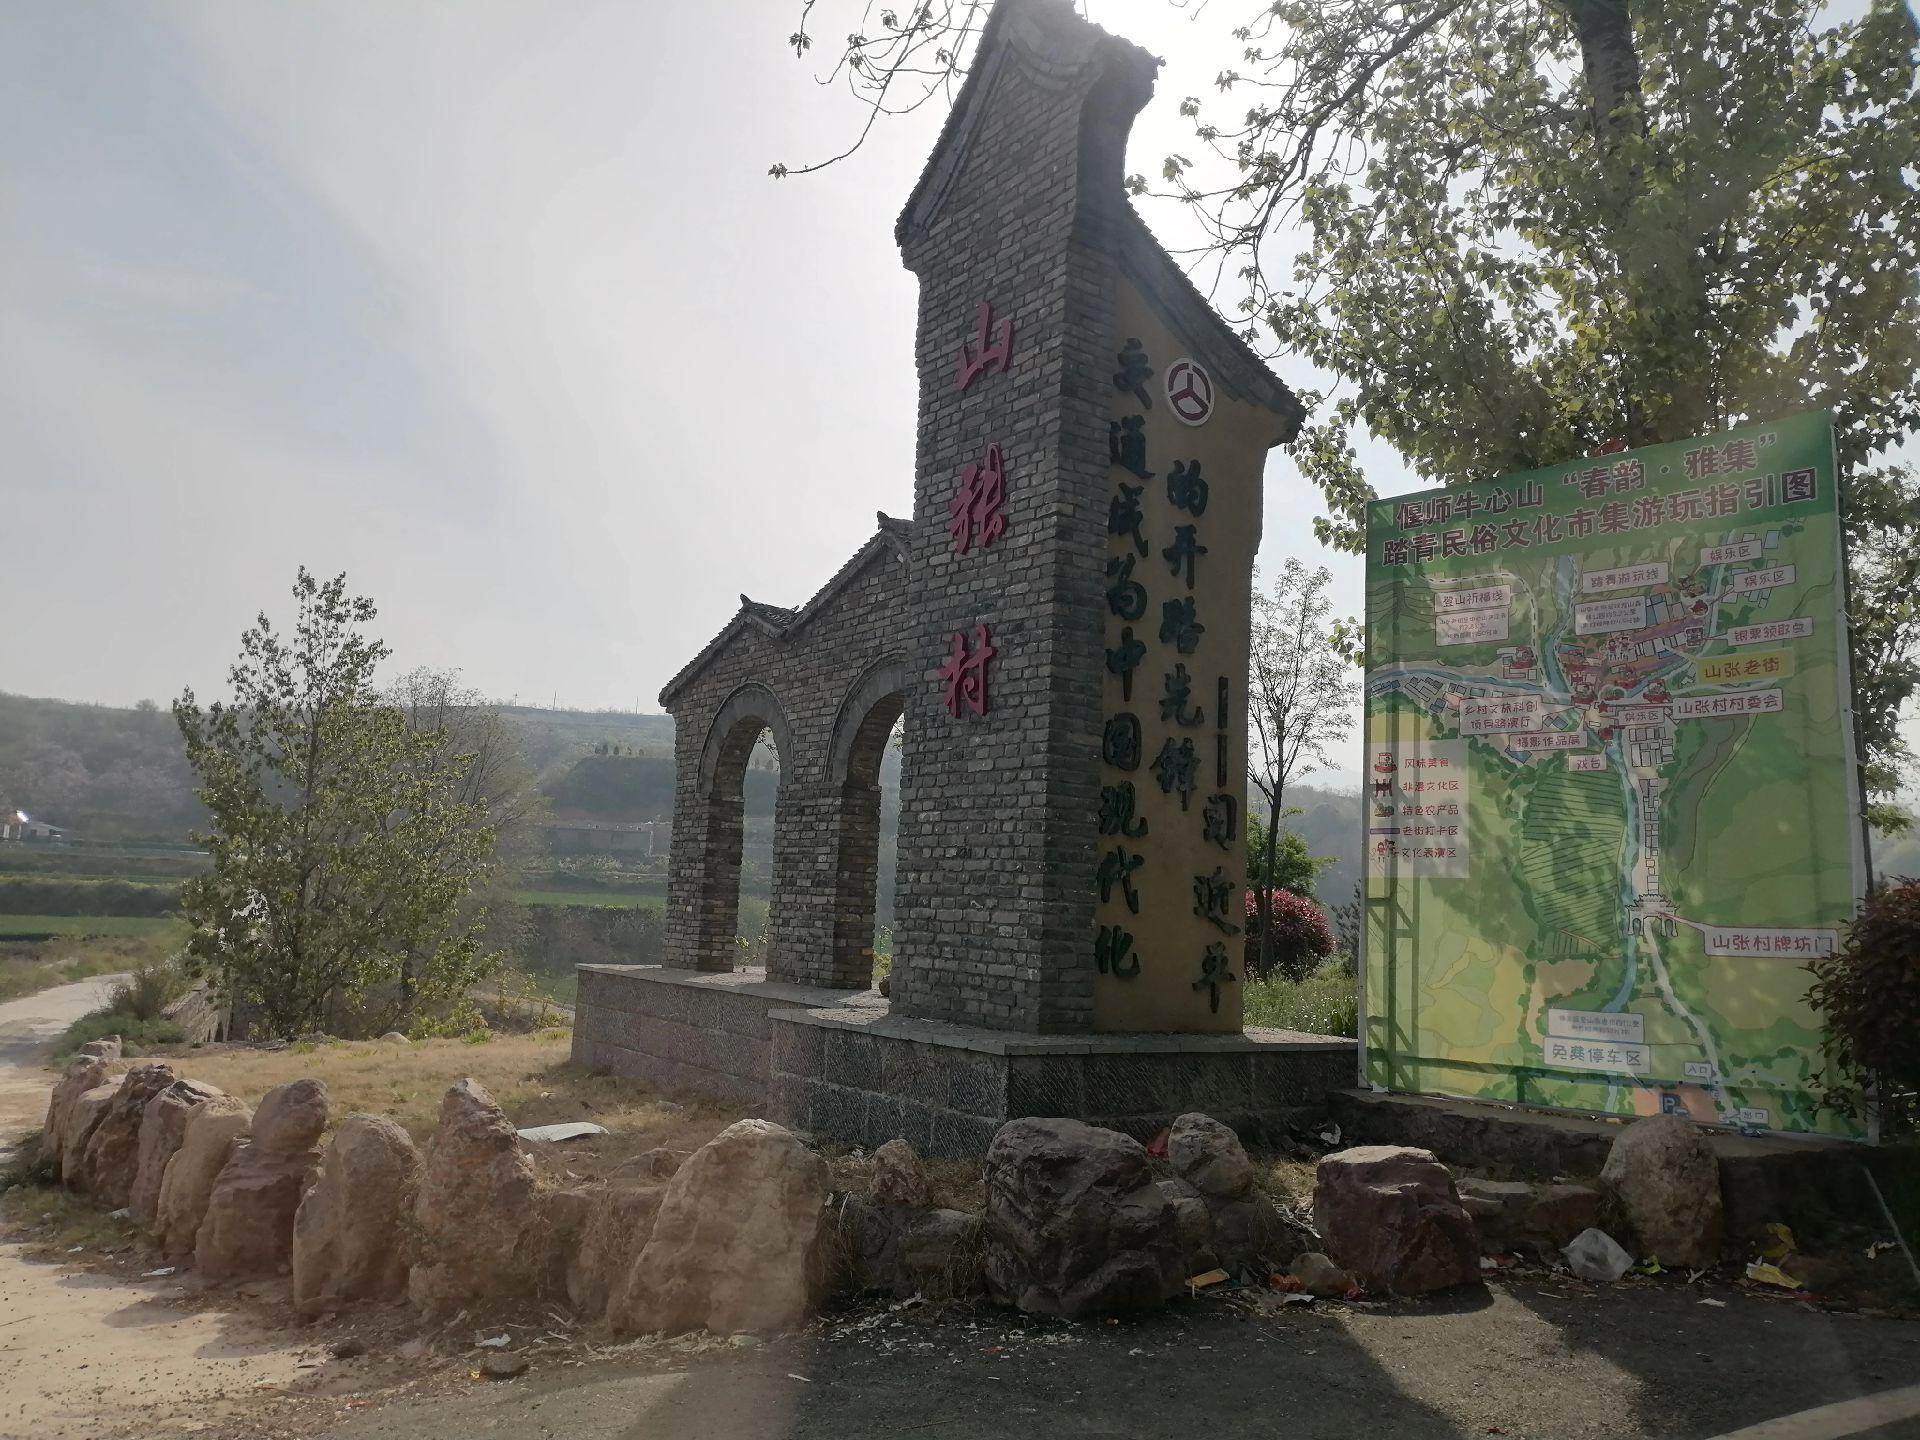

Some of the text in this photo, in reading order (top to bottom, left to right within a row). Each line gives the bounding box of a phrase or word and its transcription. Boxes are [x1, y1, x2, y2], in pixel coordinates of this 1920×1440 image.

[1397, 480, 1544, 531] 偃师牛心山
[1382, 468, 1817, 567] 踏青民俗文化市集游玩指引图
[1710, 547, 1750, 562] 娱乐区
[1744, 569, 1785, 588] 娱乐区
[1705, 656, 1780, 678] 山张老街
[1678, 694, 1779, 714] 山张村村委会
[1404, 758, 1449, 769] 风味美食
[1576, 757, 1601, 770] 戏台
[1402, 780, 1460, 792] 非遗文化区
[1402, 804, 1459, 817] 特色农产品
[1402, 825, 1459, 836] 老街打卡区
[1401, 847, 1457, 858] 文化表演区
[1712, 934, 1833, 953] 山张村牌坊门
[1552, 1043, 1642, 1066] 免费停车区
